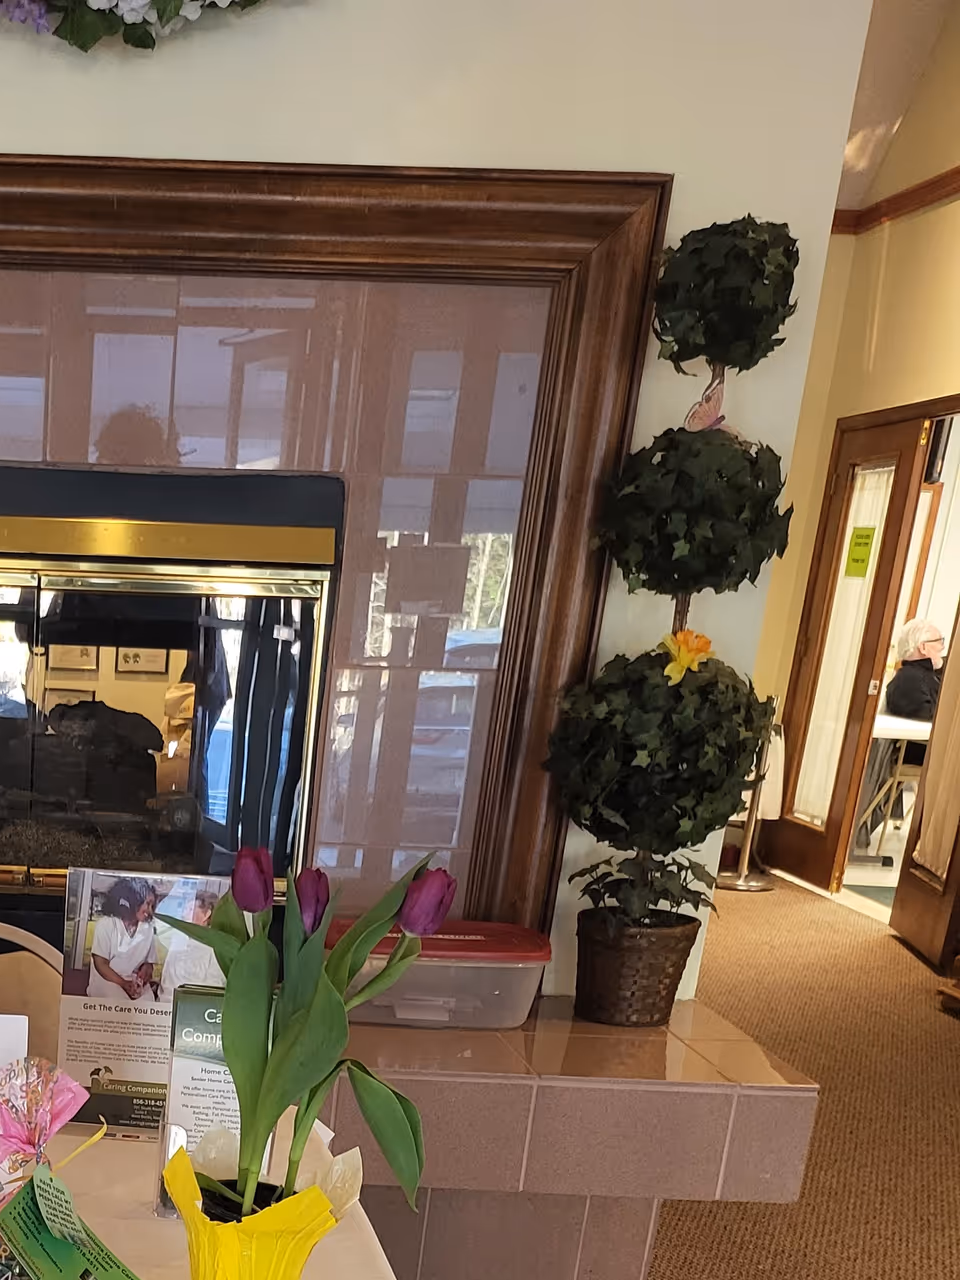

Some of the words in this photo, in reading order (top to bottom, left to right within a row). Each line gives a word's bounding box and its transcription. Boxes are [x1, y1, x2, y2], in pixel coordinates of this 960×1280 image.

[83, 1002, 97, 1011] Get
[98, 1003, 113, 1012] The
[114, 1005, 132, 1014] Care
[133, 1006, 148, 1015] You
[149, 1008, 172, 1017] Deser
[200, 1067, 222, 1076] Home
[103, 1082, 126, 1093] Caring
[127, 1085, 167, 1095] Companion
[132, 1098, 166, 1107] 856-318-451
[104, 1251, 121, 1270] Home
